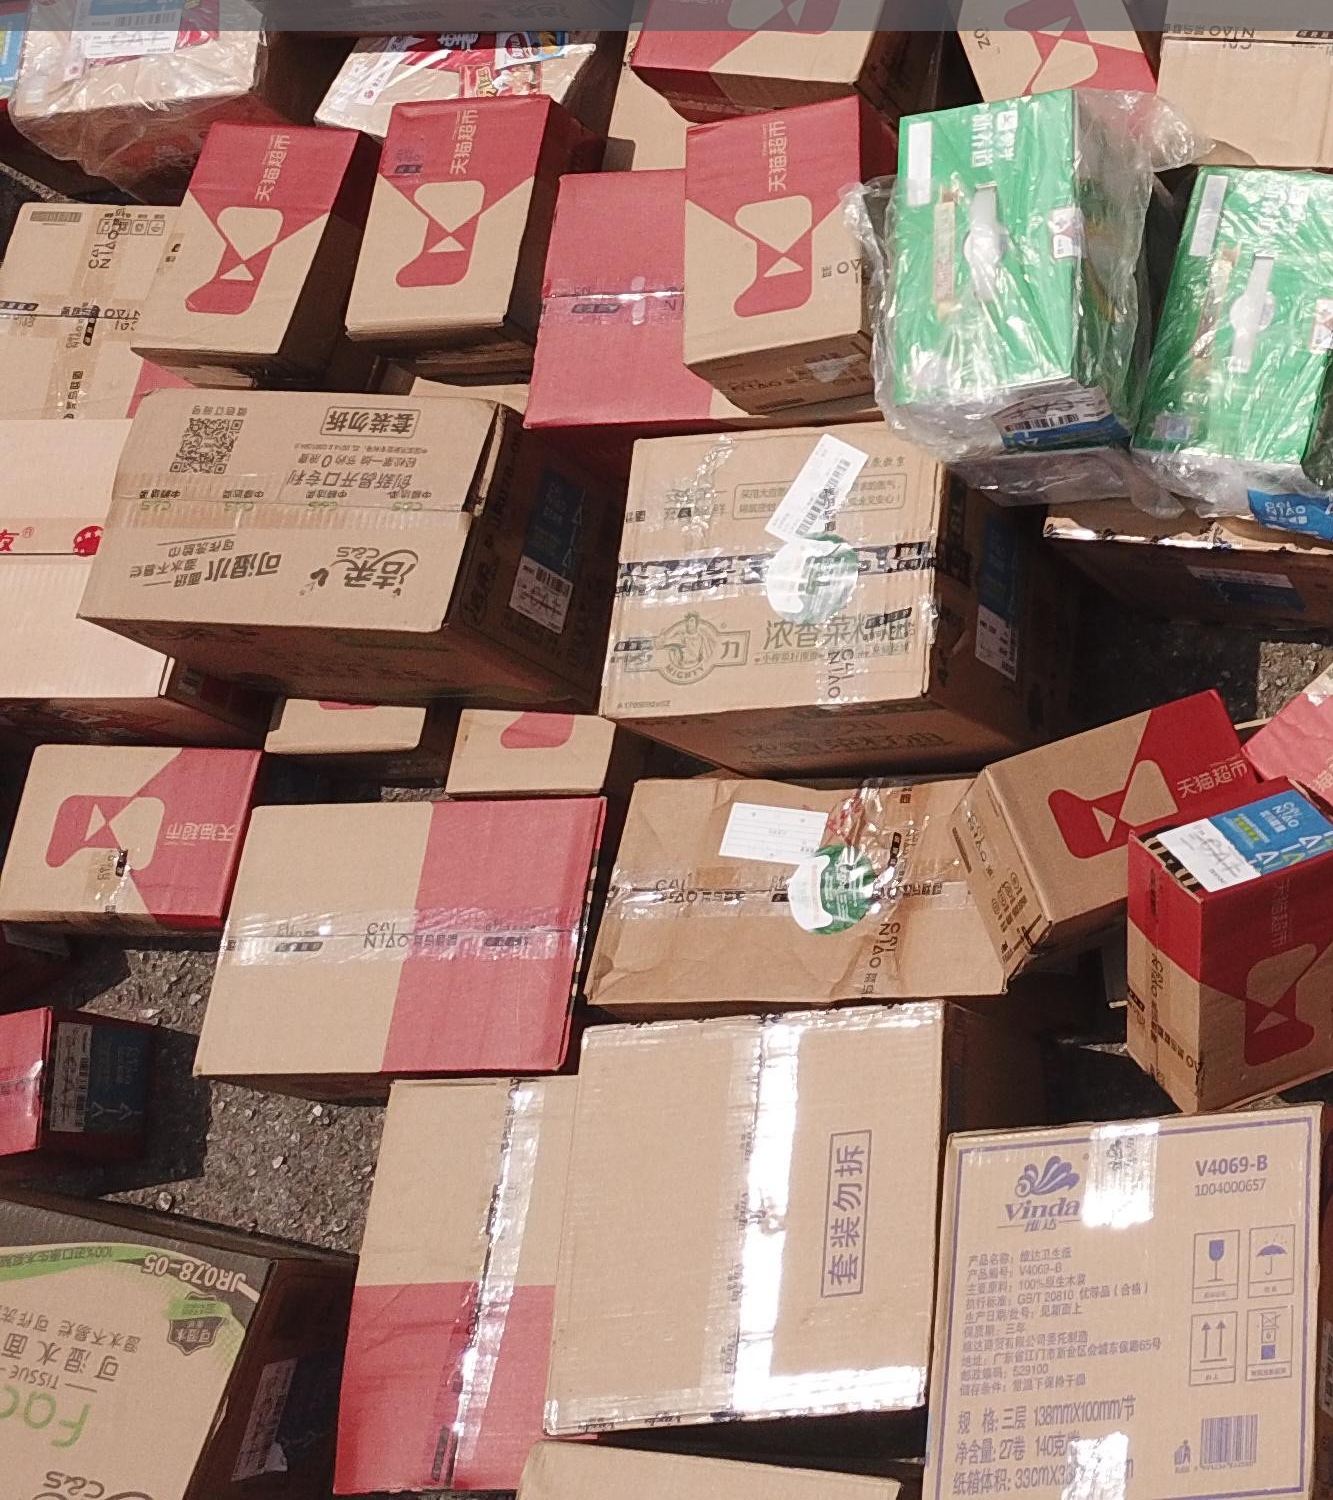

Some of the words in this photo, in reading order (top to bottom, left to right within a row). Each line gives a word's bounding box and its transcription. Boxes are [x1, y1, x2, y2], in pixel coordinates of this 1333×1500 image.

[449, 109, 477, 176] 天猫超市
[769, 120, 786, 193] 天猫超市
[256, 134, 290, 202] 天猫超市
[325, 410, 418, 436] 套装勿拆
[344, 553, 420, 597] 洁柔
[1177, 759, 1249, 799] 天猫超市
[1195, 1154, 1269, 1178] V4069-B
[1004, 1197, 1081, 1222] Vinda
[1194, 1179, 1267, 1198] 1004000657
[828, 1144, 868, 1292] 套装勿拆
[141, 1251, 246, 1293] JR078-05
